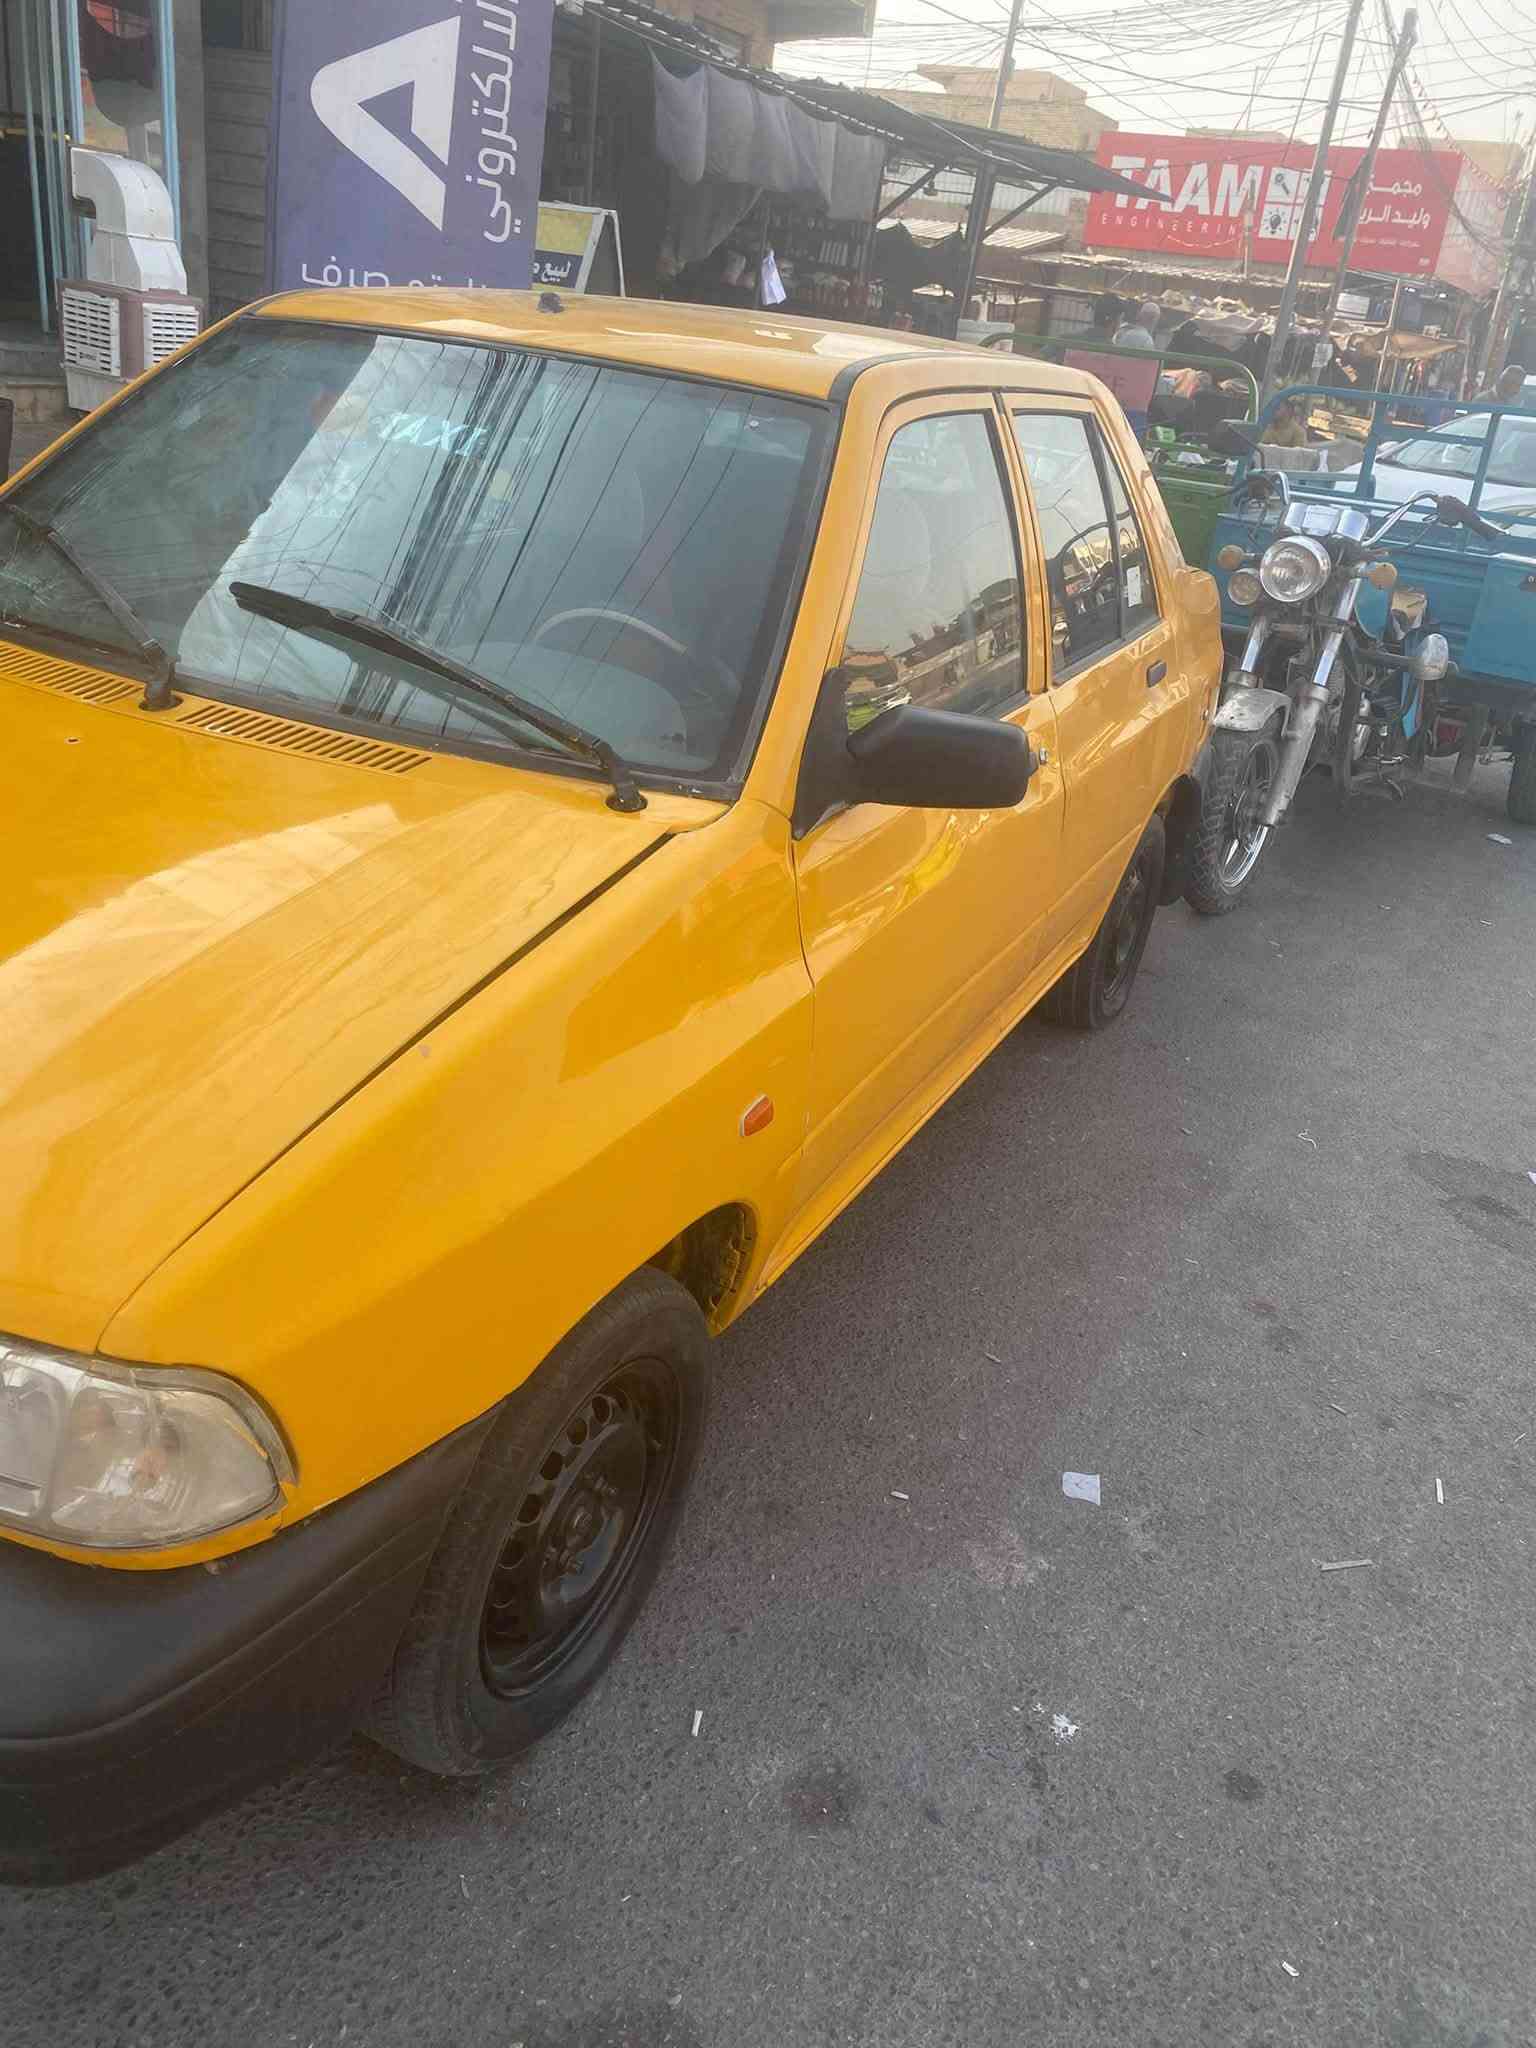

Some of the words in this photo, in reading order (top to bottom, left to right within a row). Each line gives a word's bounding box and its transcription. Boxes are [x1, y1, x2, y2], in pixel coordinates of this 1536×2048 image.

[465, 0, 522, 243] لالكتروني
[1111, 155, 1265, 218] TAAM
[1101, 213, 1239, 236] ENGINEERIN
[378, 412, 487, 457] TAXI
